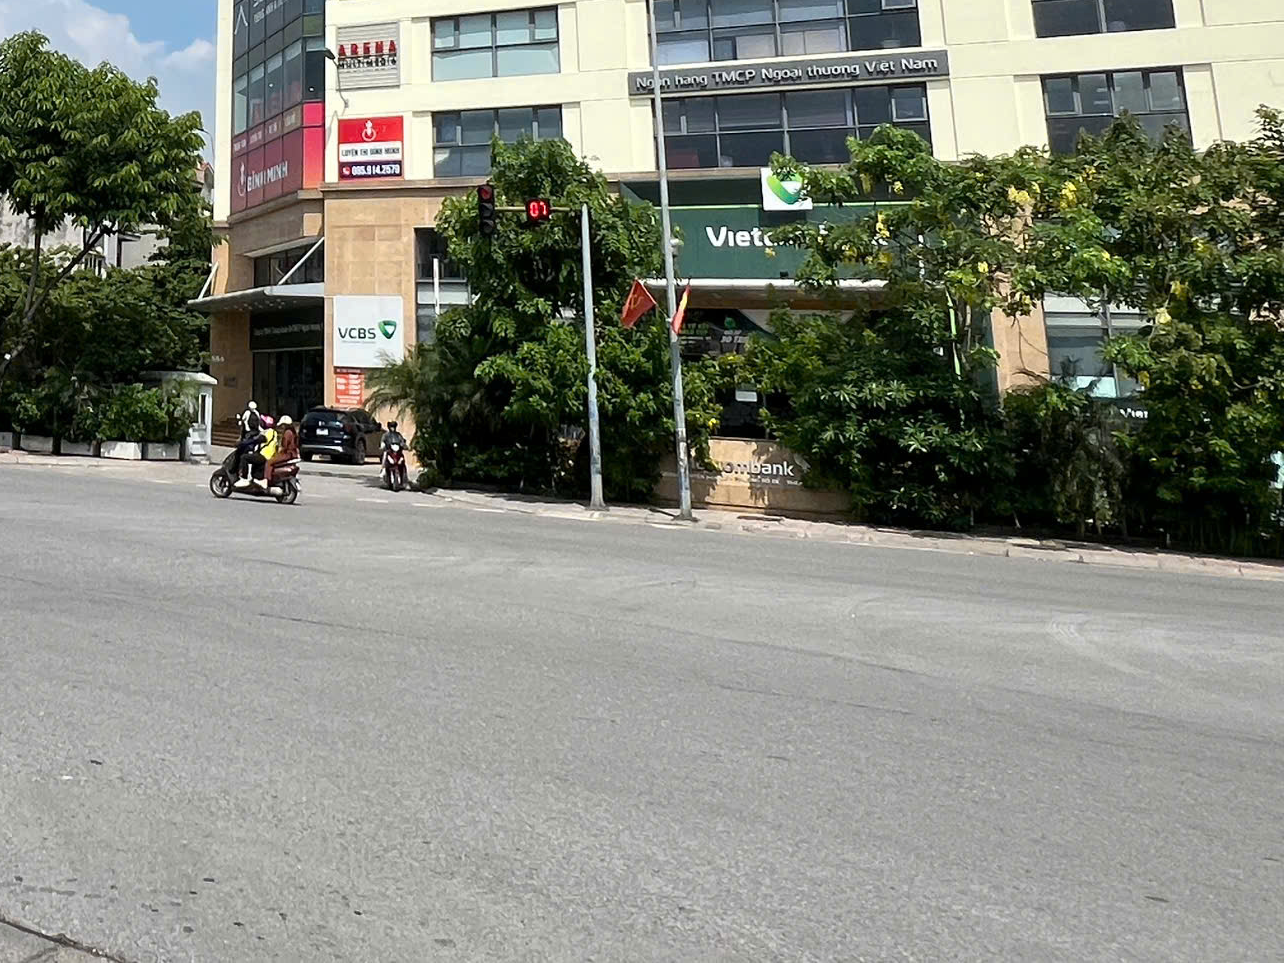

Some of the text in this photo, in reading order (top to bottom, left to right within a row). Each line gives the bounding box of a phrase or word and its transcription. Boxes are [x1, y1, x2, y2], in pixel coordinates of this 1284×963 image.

[338, 40, 397, 57] ARENA
[711, 69, 755, 82] TMCP
[901, 58, 938, 70] Nam
[338, 326, 377, 340] VCBS
